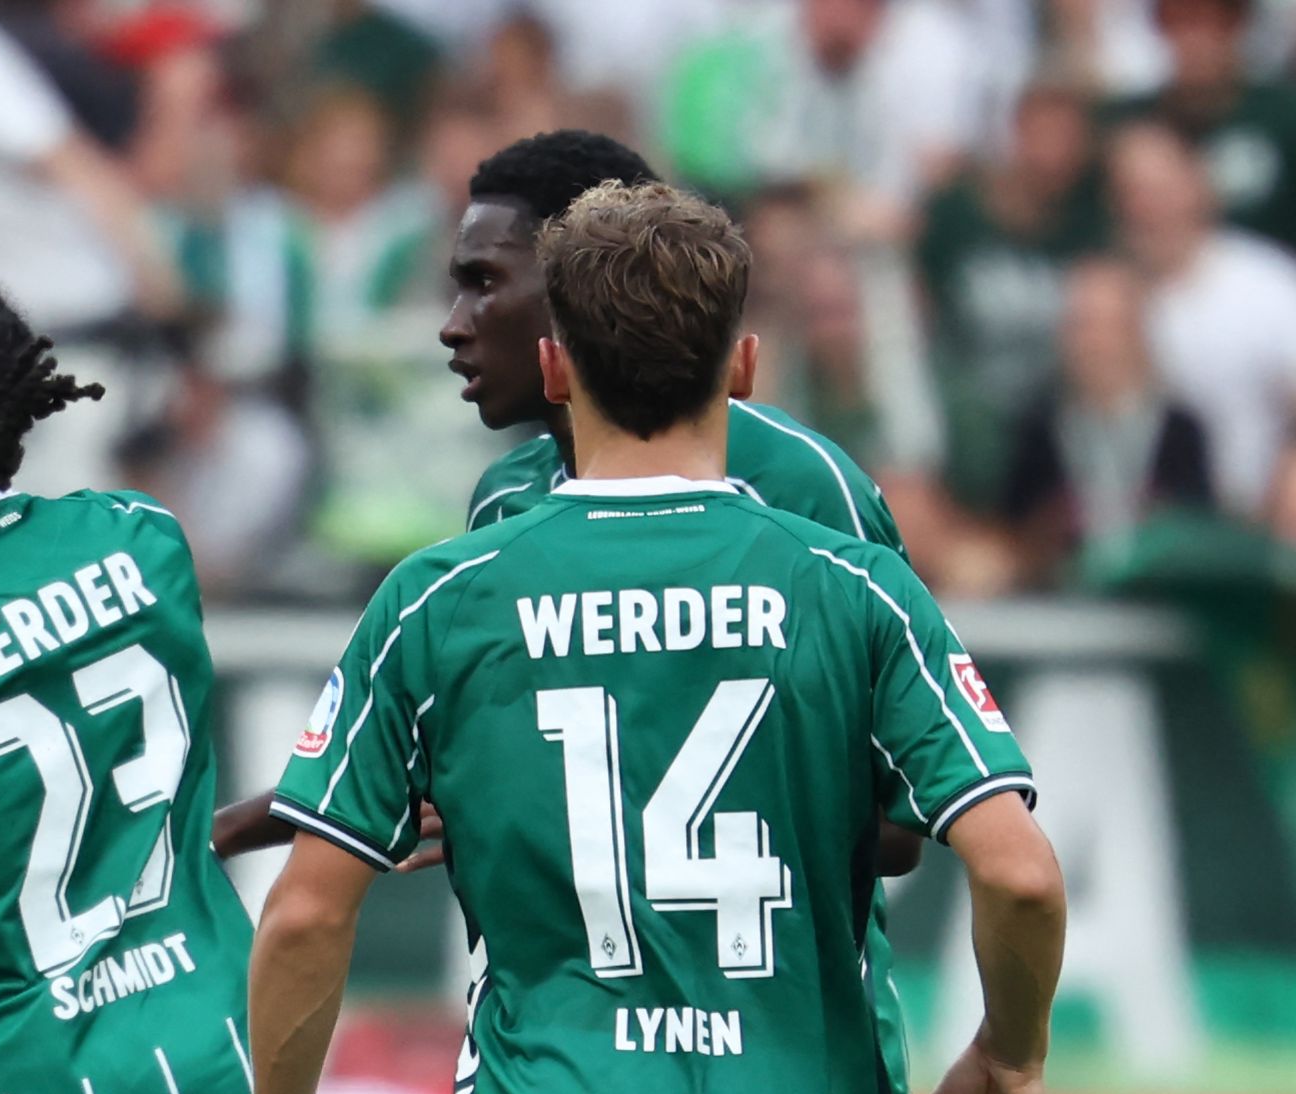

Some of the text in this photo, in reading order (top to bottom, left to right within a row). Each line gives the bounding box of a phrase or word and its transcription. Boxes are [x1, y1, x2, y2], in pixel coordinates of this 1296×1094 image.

[515, 585, 787, 659] WERDER
[535, 678, 792, 979] 14
[50, 932, 197, 1020] SCHMIDT
[615, 1007, 743, 1057] LYNEN
